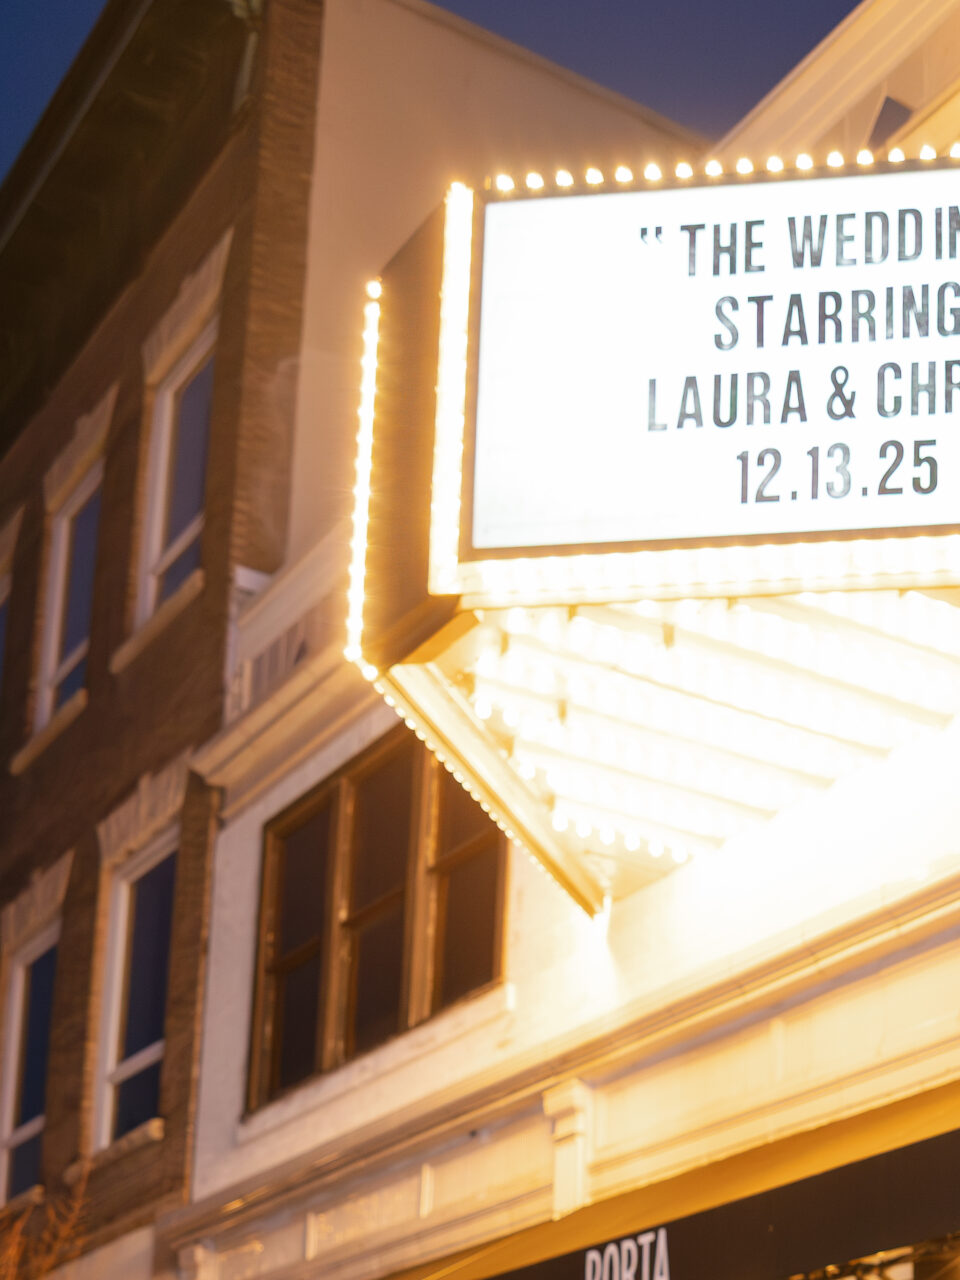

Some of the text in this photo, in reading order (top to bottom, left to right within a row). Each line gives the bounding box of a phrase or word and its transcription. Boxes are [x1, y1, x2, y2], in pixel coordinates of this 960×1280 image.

[647, 369, 808, 432] LAURA
[826, 365, 857, 421] &
[736, 438, 939, 504] 12.13.25
